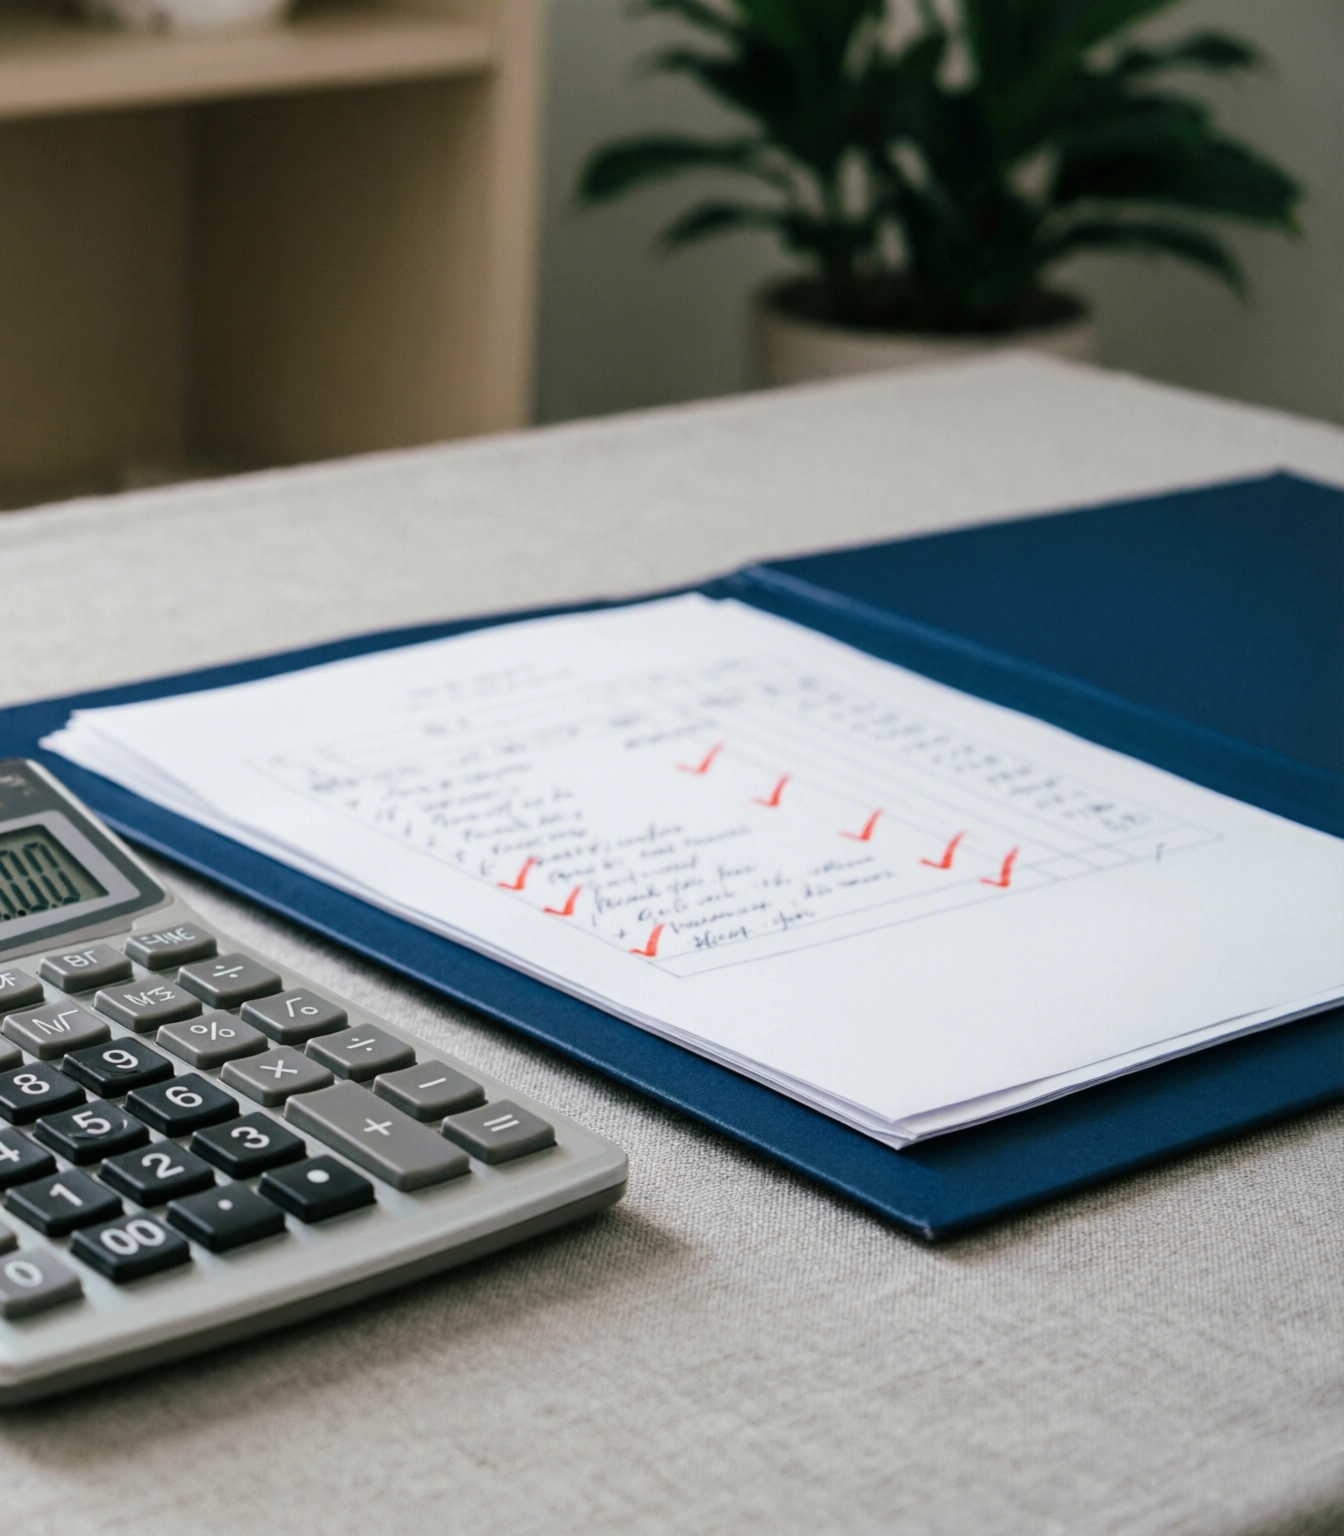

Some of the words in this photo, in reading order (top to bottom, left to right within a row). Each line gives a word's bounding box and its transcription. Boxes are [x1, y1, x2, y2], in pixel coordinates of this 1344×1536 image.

[189, 1021, 236, 1042] %
[102, 1049, 139, 1069] 9
[13, 1073, 50, 1095] 8
[165, 1086, 203, 1108] 6
[72, 1110, 111, 1136] 5
[363, 1117, 393, 1136] +
[230, 1126, 270, 1149] 3
[141, 1152, 185, 1179] 2
[49, 1183, 83, 1207] 1
[100, 1218, 167, 1256] 00
[4, 1260, 43, 1287] 0
